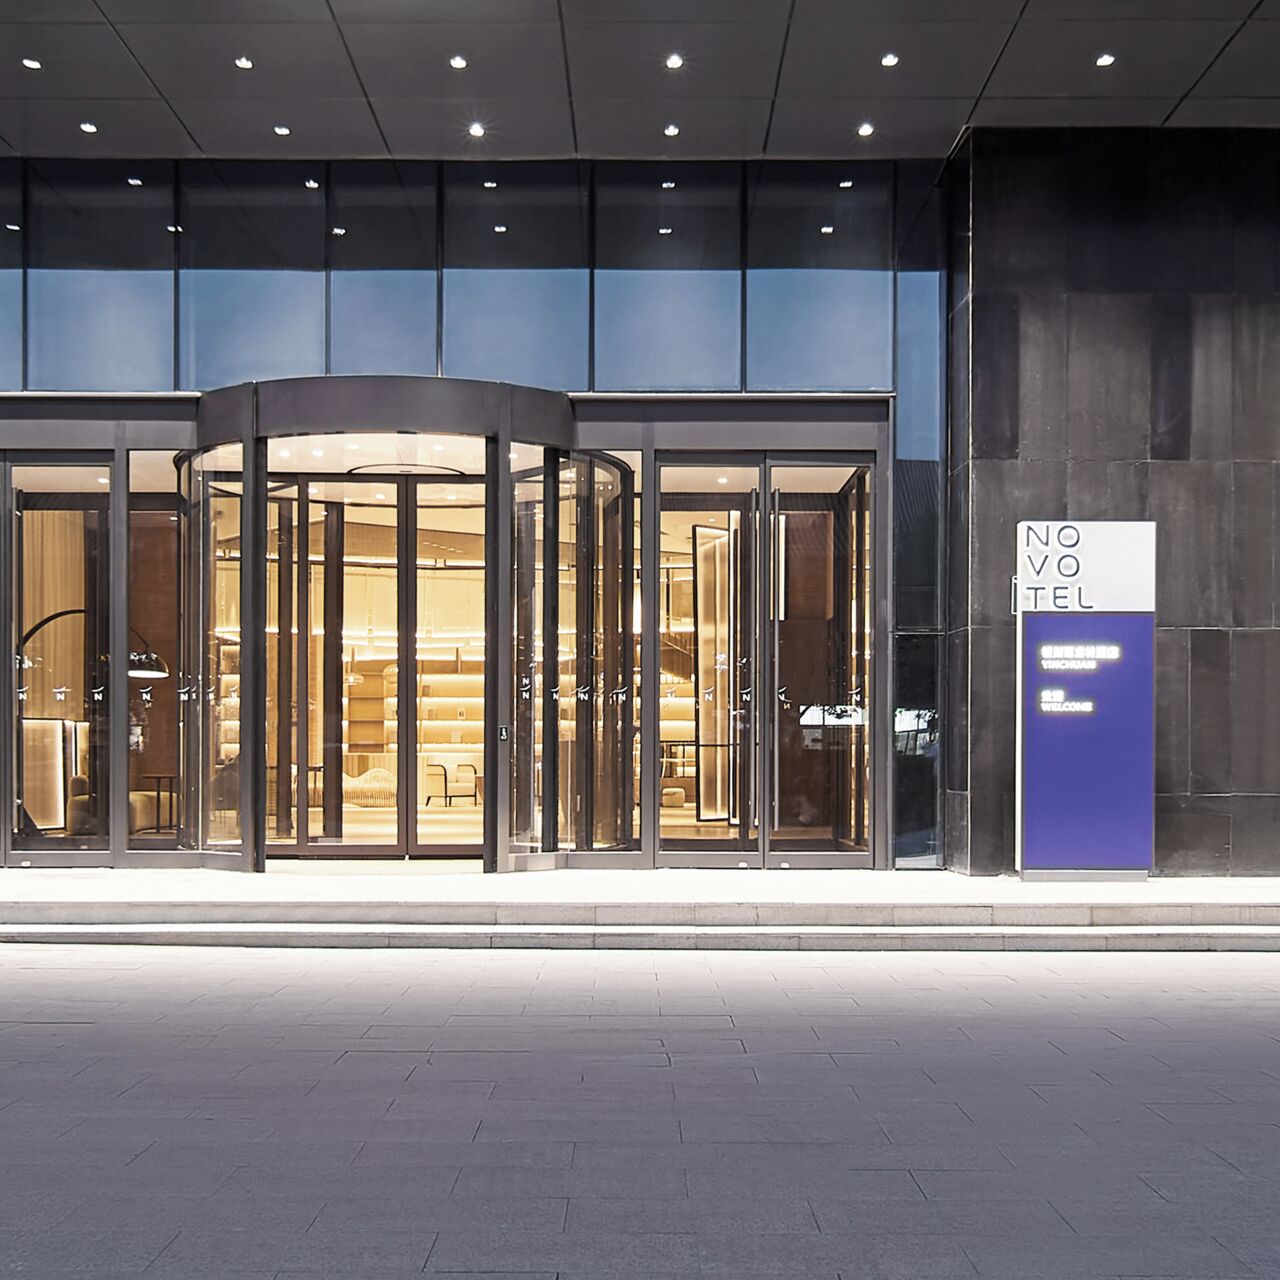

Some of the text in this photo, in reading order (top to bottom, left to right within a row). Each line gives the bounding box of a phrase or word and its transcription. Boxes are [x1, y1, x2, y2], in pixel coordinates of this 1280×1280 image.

[1026, 525, 1080, 548] NO
[1026, 554, 1080, 577] VO
[1026, 586, 1094, 610] TEL
